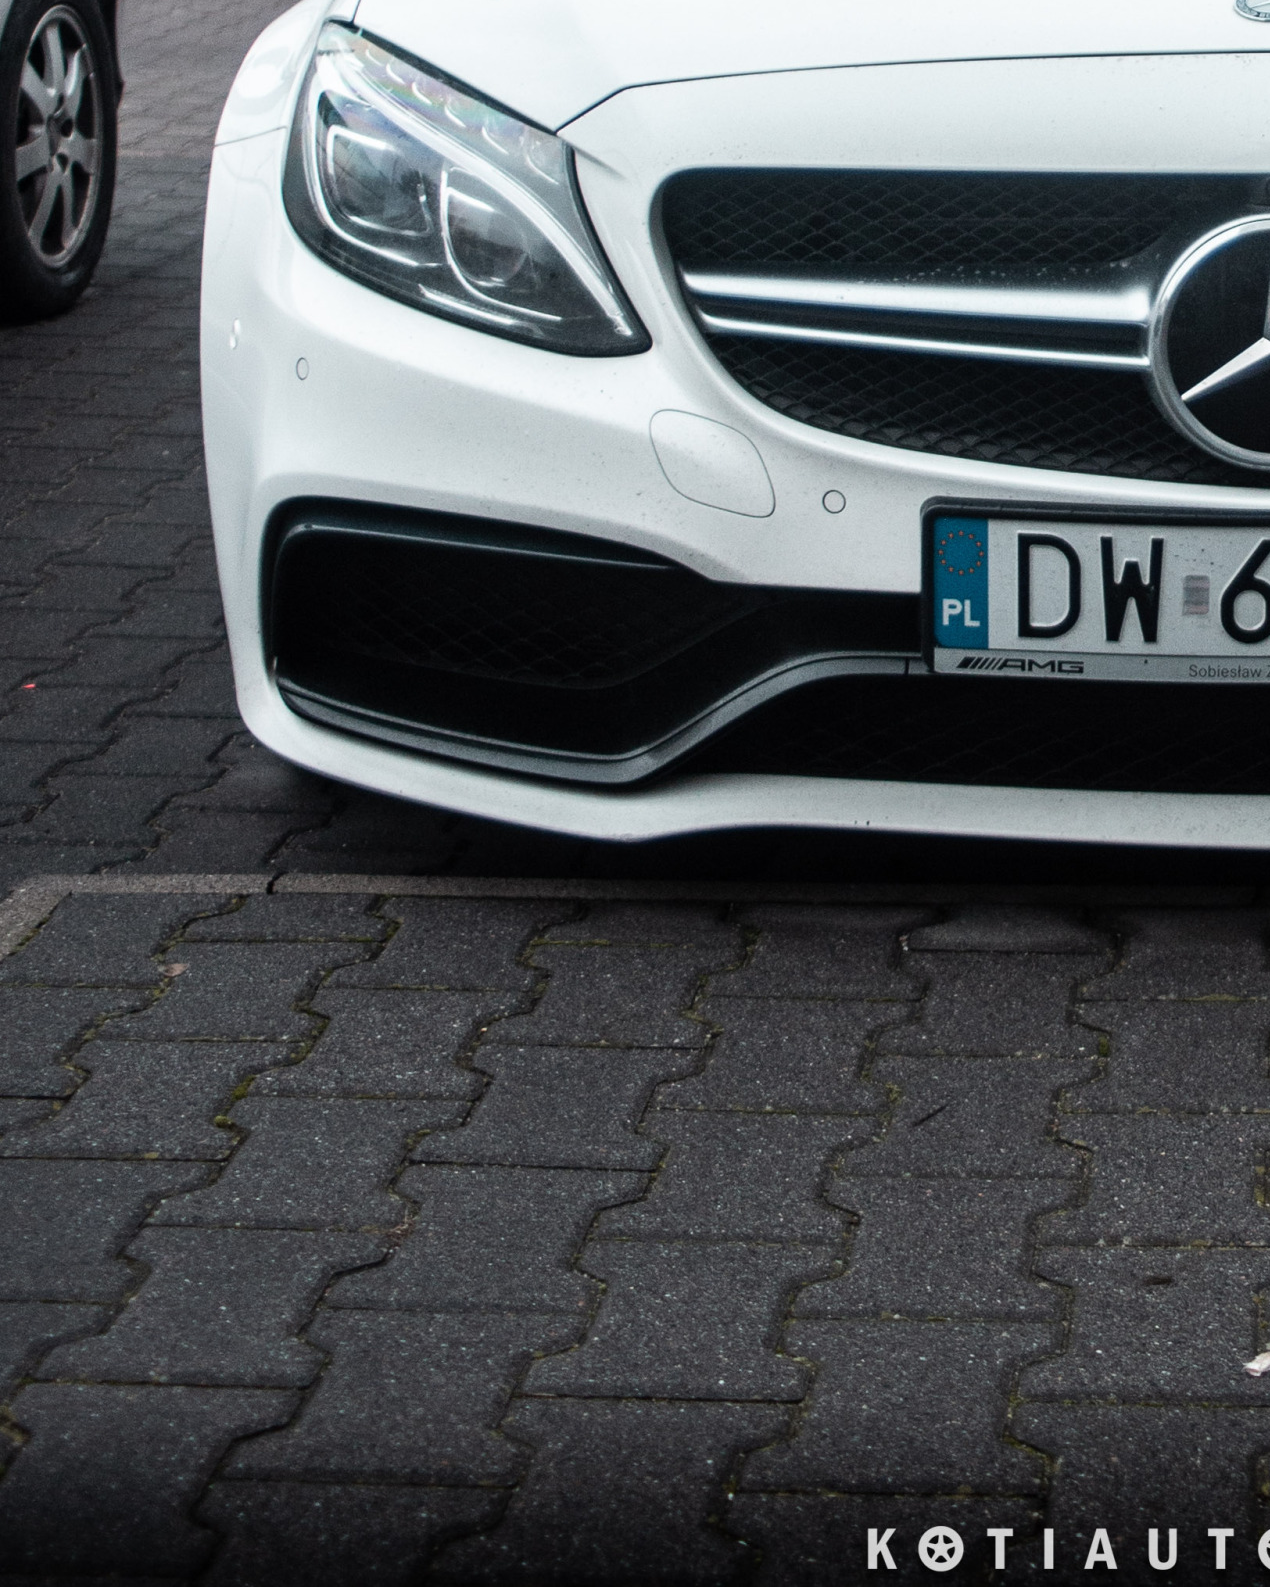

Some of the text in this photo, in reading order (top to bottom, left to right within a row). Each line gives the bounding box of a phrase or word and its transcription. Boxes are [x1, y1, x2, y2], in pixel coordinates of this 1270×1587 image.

[1016, 532, 1165, 645] DW
[942, 598, 980, 627] PL
[998, 657, 1084, 675] AMG
[1188, 664, 1262, 679] Sobiesław
